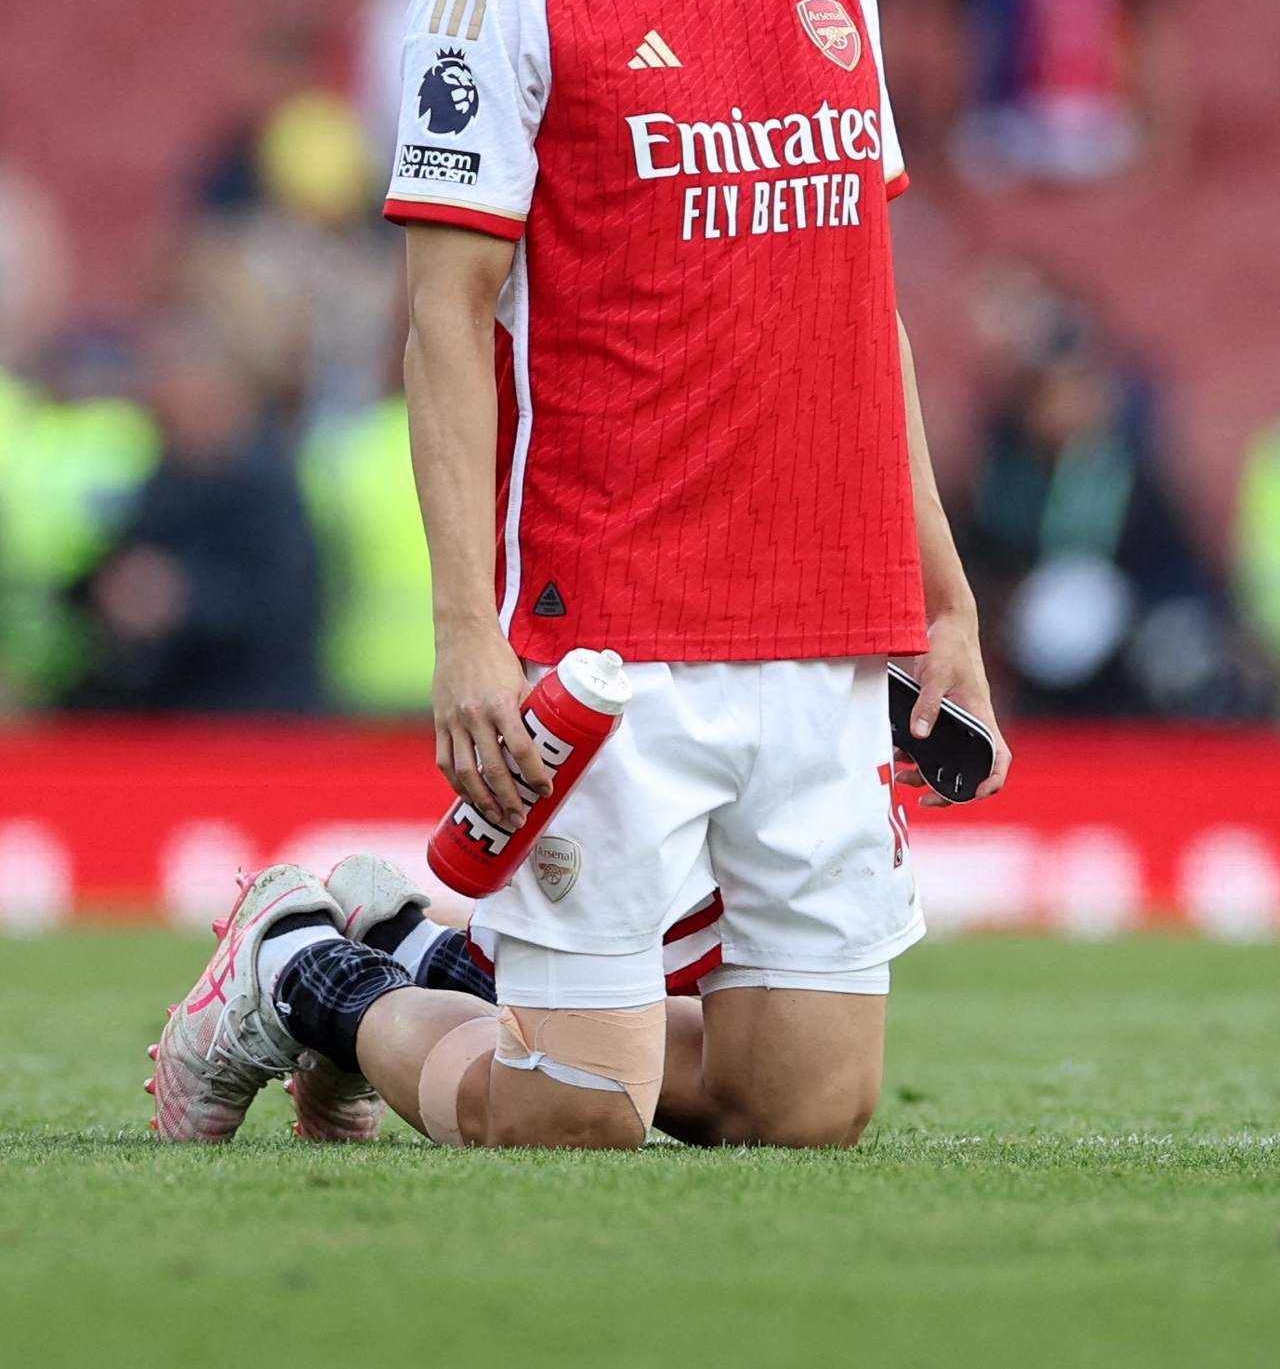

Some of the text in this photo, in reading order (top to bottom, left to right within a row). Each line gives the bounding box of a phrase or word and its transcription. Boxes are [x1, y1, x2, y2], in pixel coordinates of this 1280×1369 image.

[625, 100, 881, 179] Emirates
[400, 145, 472, 169] No room
[419, 164, 477, 185] racism
[682, 174, 860, 240] FLY BETTER
[537, 845, 573, 862] Arsenal
